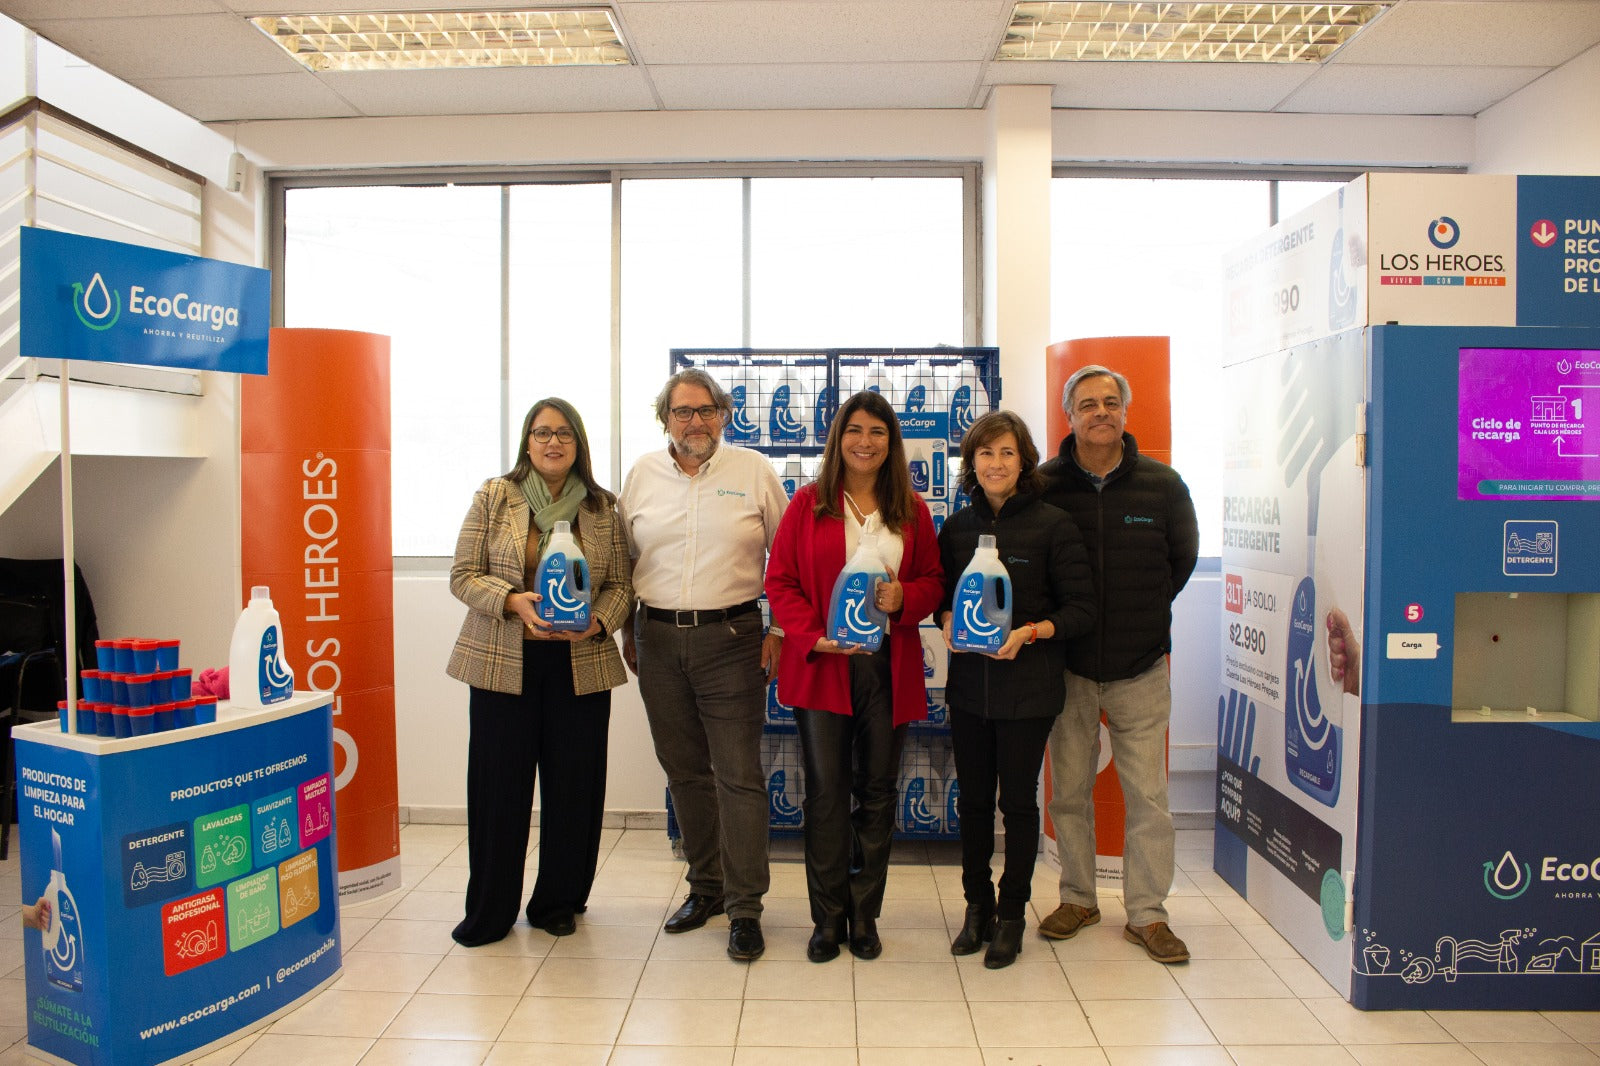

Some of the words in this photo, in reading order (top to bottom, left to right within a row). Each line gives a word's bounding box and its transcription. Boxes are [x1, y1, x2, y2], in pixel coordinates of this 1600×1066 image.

[1564, 238, 1600, 254] REC
[1380, 254, 1419, 271] LOS
[1426, 254, 1505, 272] HEROES
[1564, 258, 1600, 274] PRO
[1436, 277, 1451, 285] CON
[1474, 278, 1498, 286] GANAS
[1564, 278, 1588, 293] DE
[130, 285, 239, 331] EcoCarga
[144, 328, 176, 338] AHORRA
[186, 334, 225, 343] REUTILIZA
[1571, 398, 1582, 420] 1
[898, 418, 936, 429] coCarga
[1472, 418, 1502, 429] Ciclo
[1506, 418, 1521, 429] de
[1472, 432, 1520, 443] recarga
[1224, 496, 1280, 526] RECARGA
[1223, 528, 1280, 554] DETERGENTE
[1506, 556, 1554, 564] DETERGENTE
[1226, 582, 1242, 605] 3LT
[1253, 590, 1276, 613] SOLO!
[1408, 606, 1419, 620] 5
[1229, 622, 1266, 655] $2.990
[1401, 642, 1422, 650] Carga
[306, 637, 342, 716] OS
[1264, 672, 1279, 684] tarjeta
[22, 766, 73, 790] PRODUCTOS
[74, 778, 86, 792] DE
[170, 777, 233, 802] PRODUCTOS
[234, 771, 253, 787] QUE
[254, 768, 264, 779] TE
[265, 754, 308, 776] OFRECEMOS
[304, 777, 327, 793] LIMPIADOR
[24, 785, 60, 805] LIMPIEZA
[62, 794, 85, 810] PARA
[257, 796, 292, 814] SUAVIZANTE
[34, 804, 42, 818] EL
[44, 807, 74, 826] HOGAR
[202, 813, 243, 832] LAVALOZAS
[129, 829, 185, 850] DETERGENTE
[285, 854, 312, 872] LIMPIADOR
[236, 873, 270, 892] LIMPIADOR
[240, 890, 249, 900] DE
[249, 882, 267, 897] BAÑO
[168, 901, 221, 924] PROFESIONAL
[172, 894, 216, 914] ANTIGRASA
[140, 982, 260, 1040] www.ecocarga.com
[276, 938, 335, 983] @ecocargachile
[36, 996, 72, 1019] ¡SÚMATE
[74, 1014, 79, 1022] A
[81, 1013, 92, 1028] LA
[33, 1010, 99, 1048] REUTILIZACIÓN!
